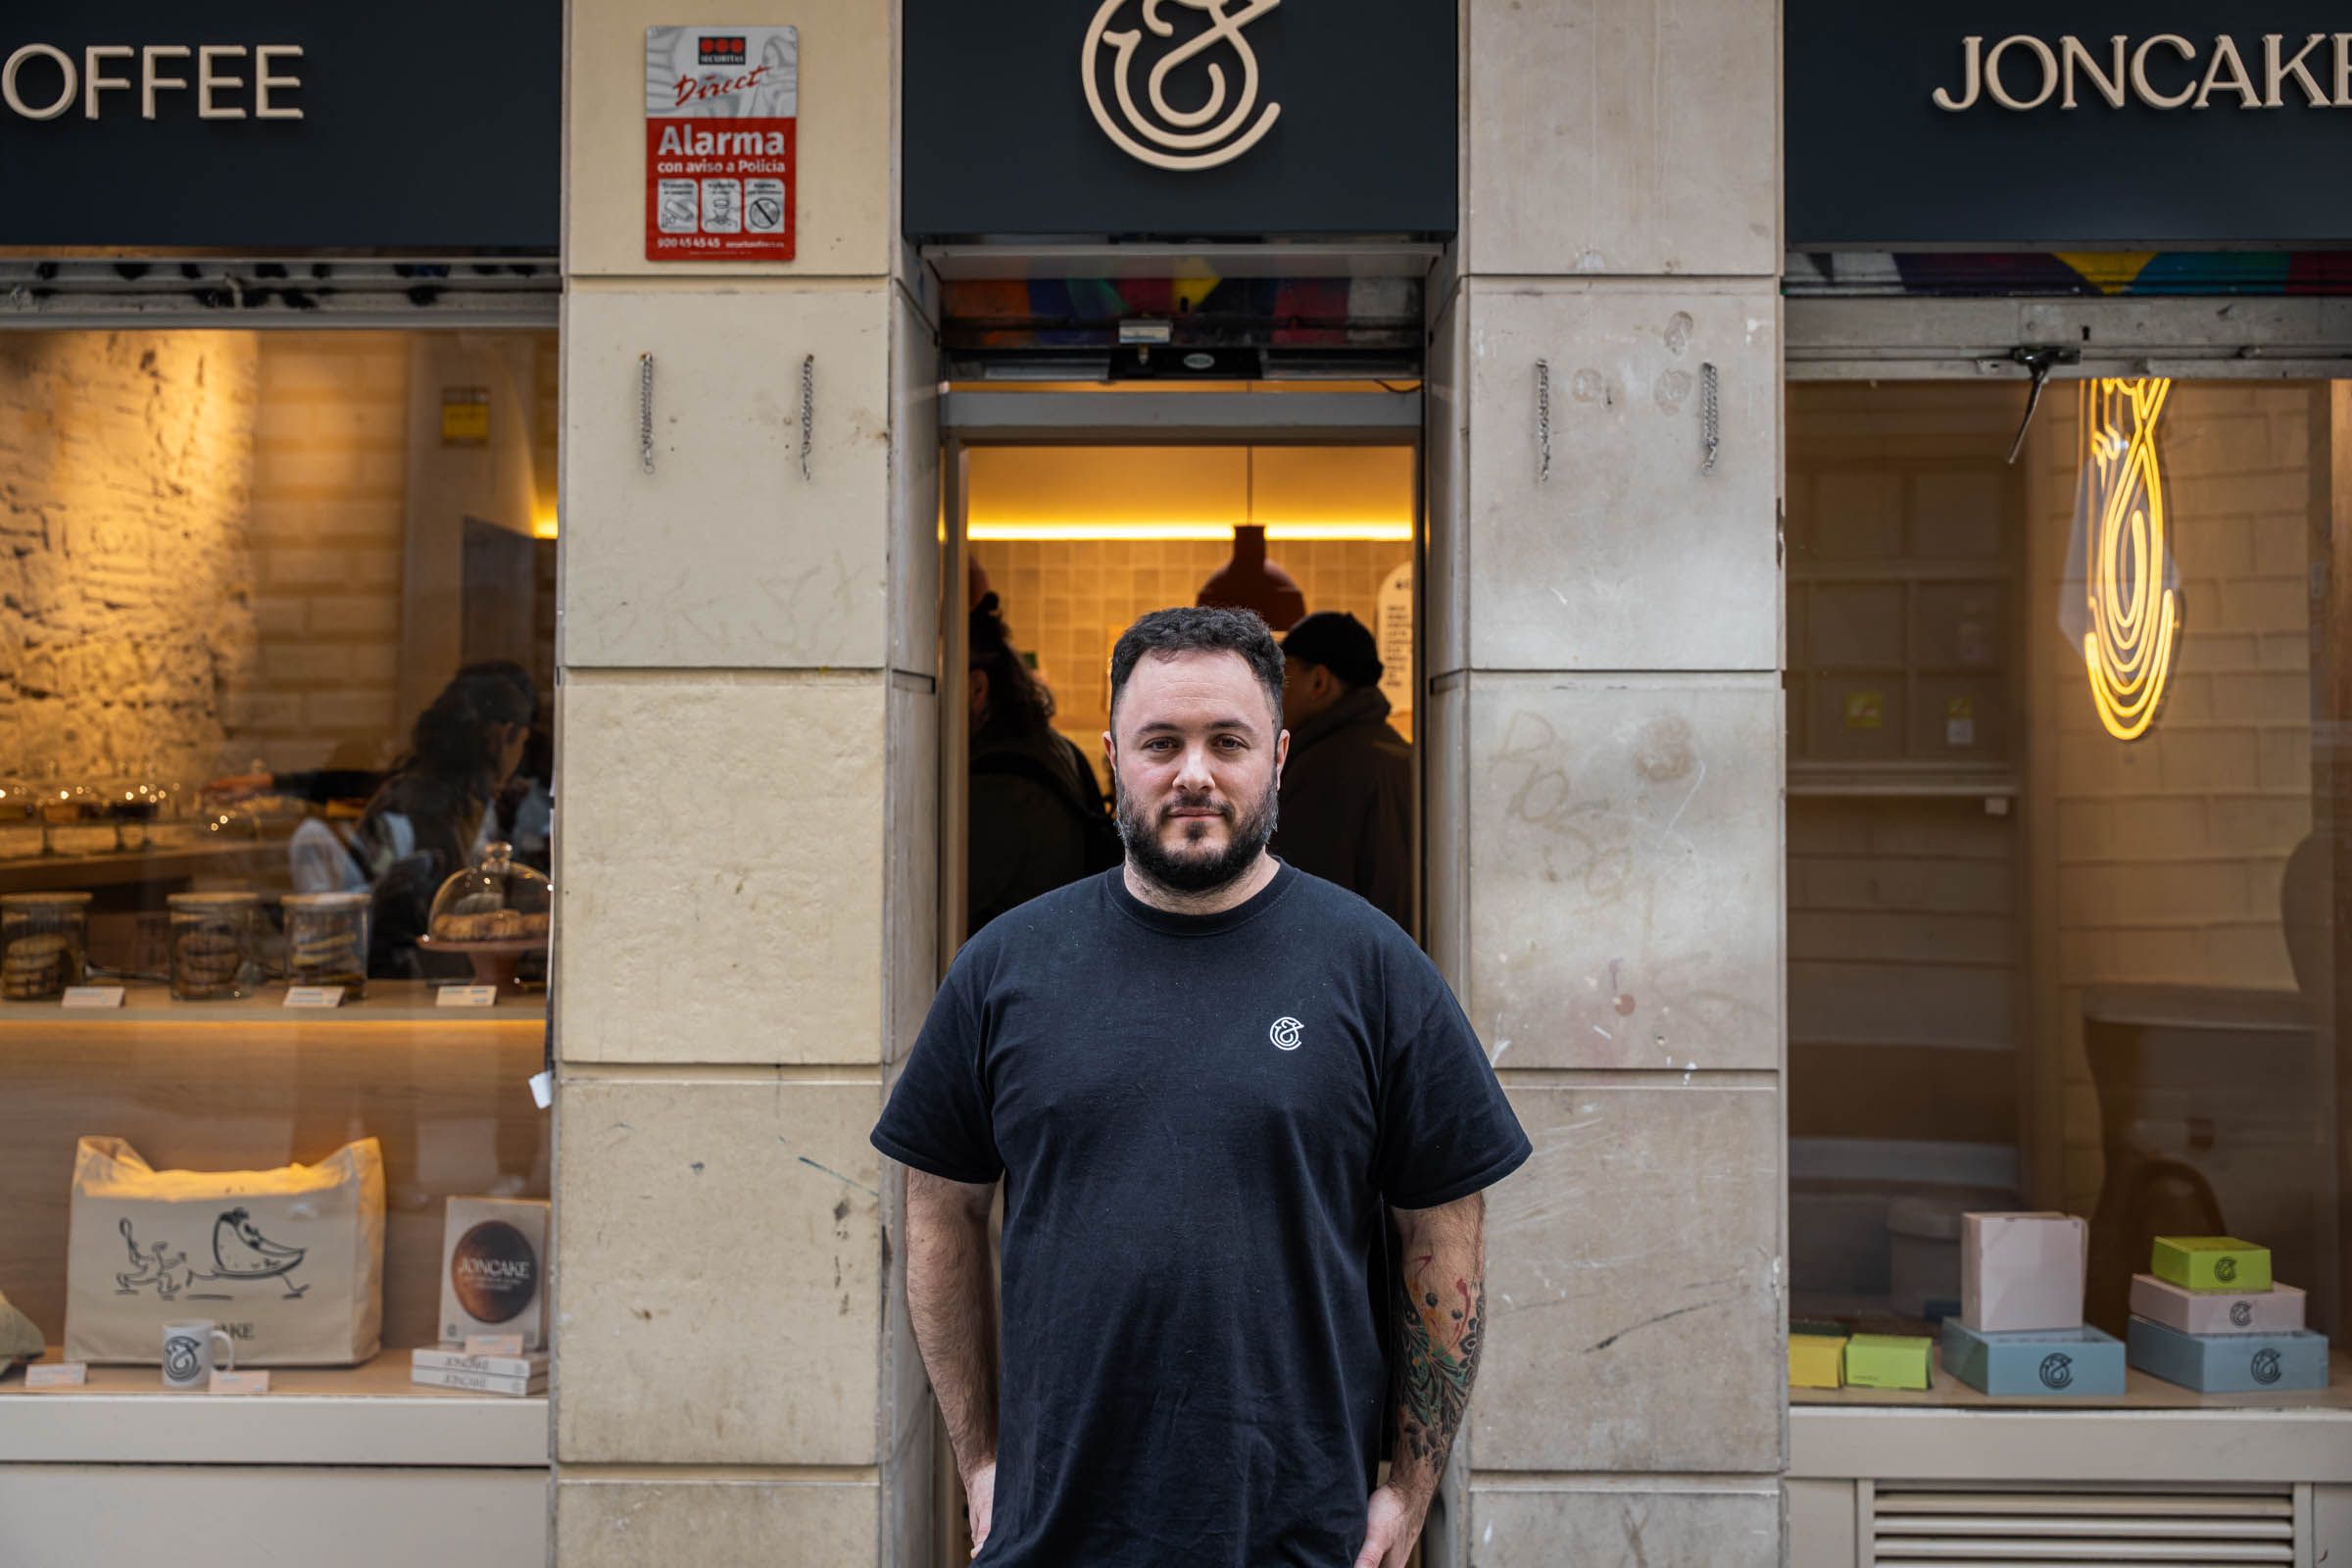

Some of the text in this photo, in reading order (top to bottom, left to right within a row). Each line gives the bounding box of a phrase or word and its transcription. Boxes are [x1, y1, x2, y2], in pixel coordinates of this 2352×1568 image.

[1, 43, 304, 120] OFFEE
[673, 64, 773, 107] Direct
[1932, 33, 2352, 112] JONCAKE
[658, 123, 785, 156] Alarma
[658, 161, 683, 173] con
[686, 159, 723, 173] aviso
[726, 161, 736, 173] a
